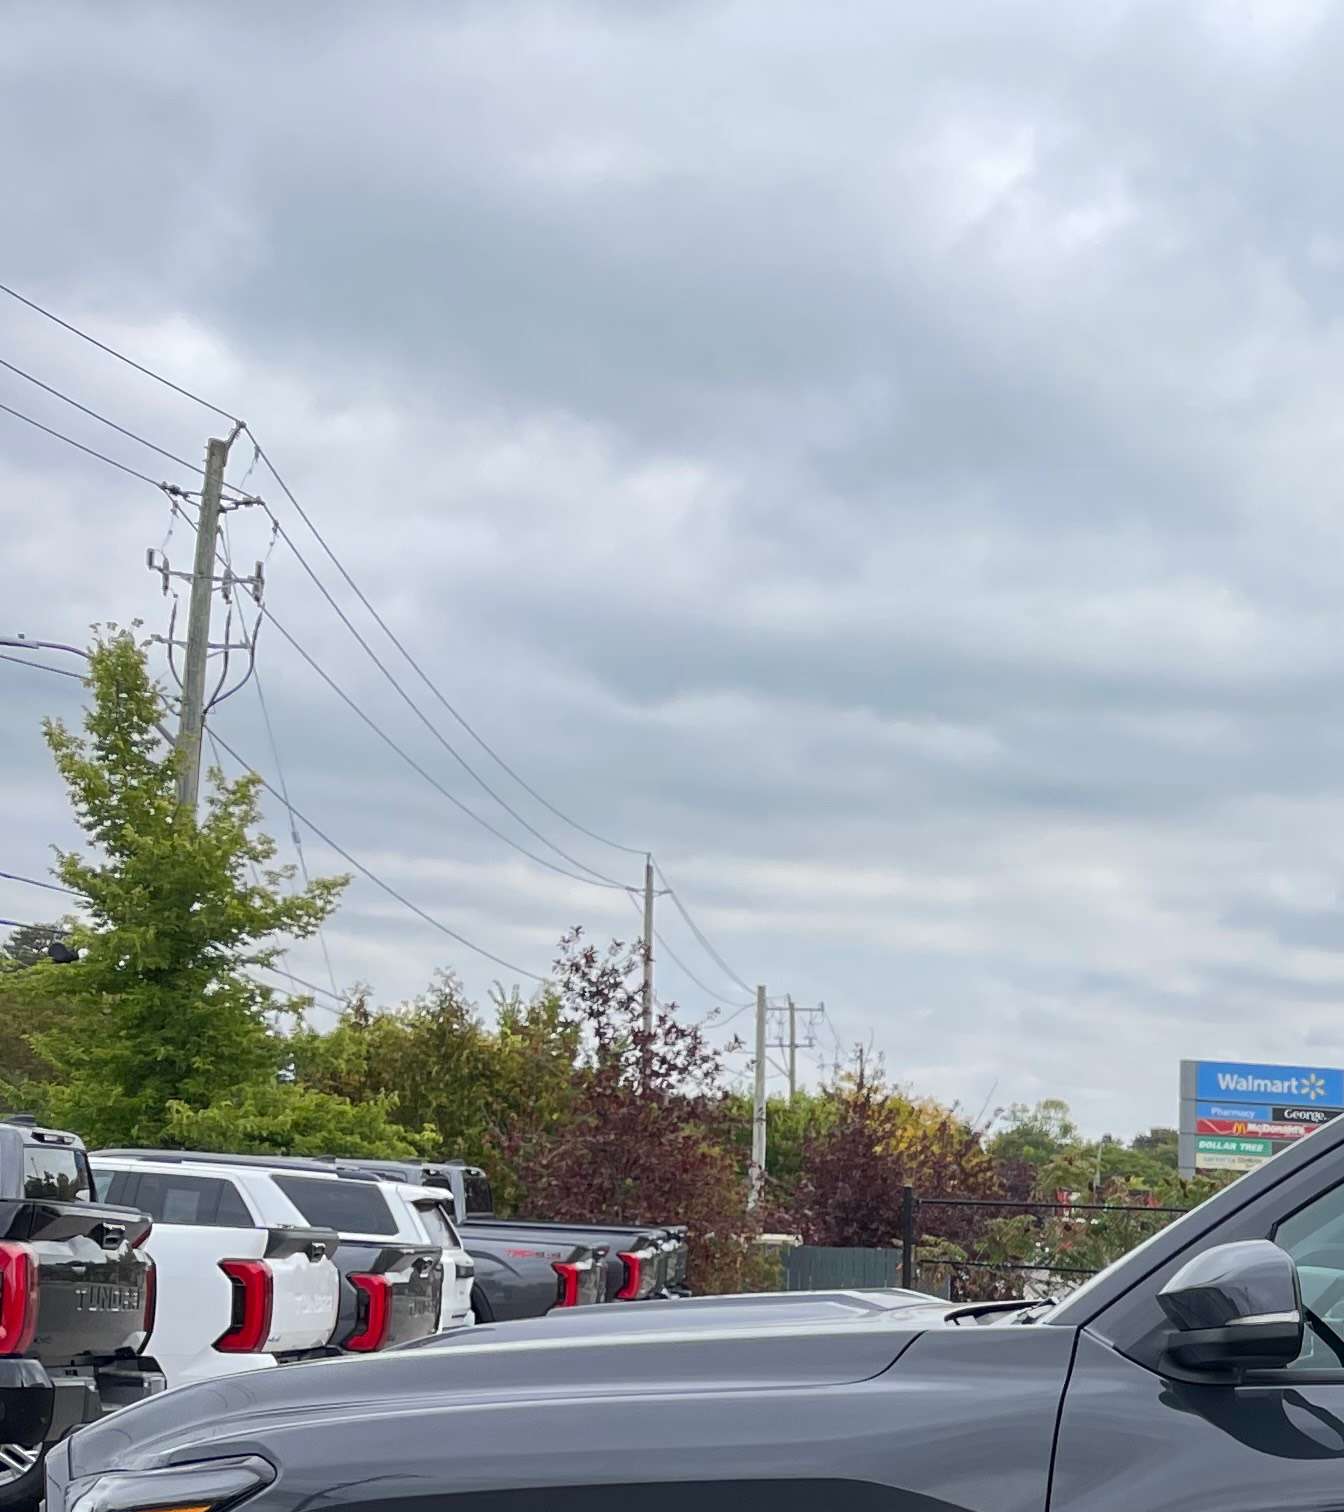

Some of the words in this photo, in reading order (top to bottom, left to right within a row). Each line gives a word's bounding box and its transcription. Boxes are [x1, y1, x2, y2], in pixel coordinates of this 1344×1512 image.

[1217, 1072, 1299, 1095] Walmart
[1199, 1140, 1237, 1151] DOLLAR
[1240, 1143, 1265, 1152] TREE
